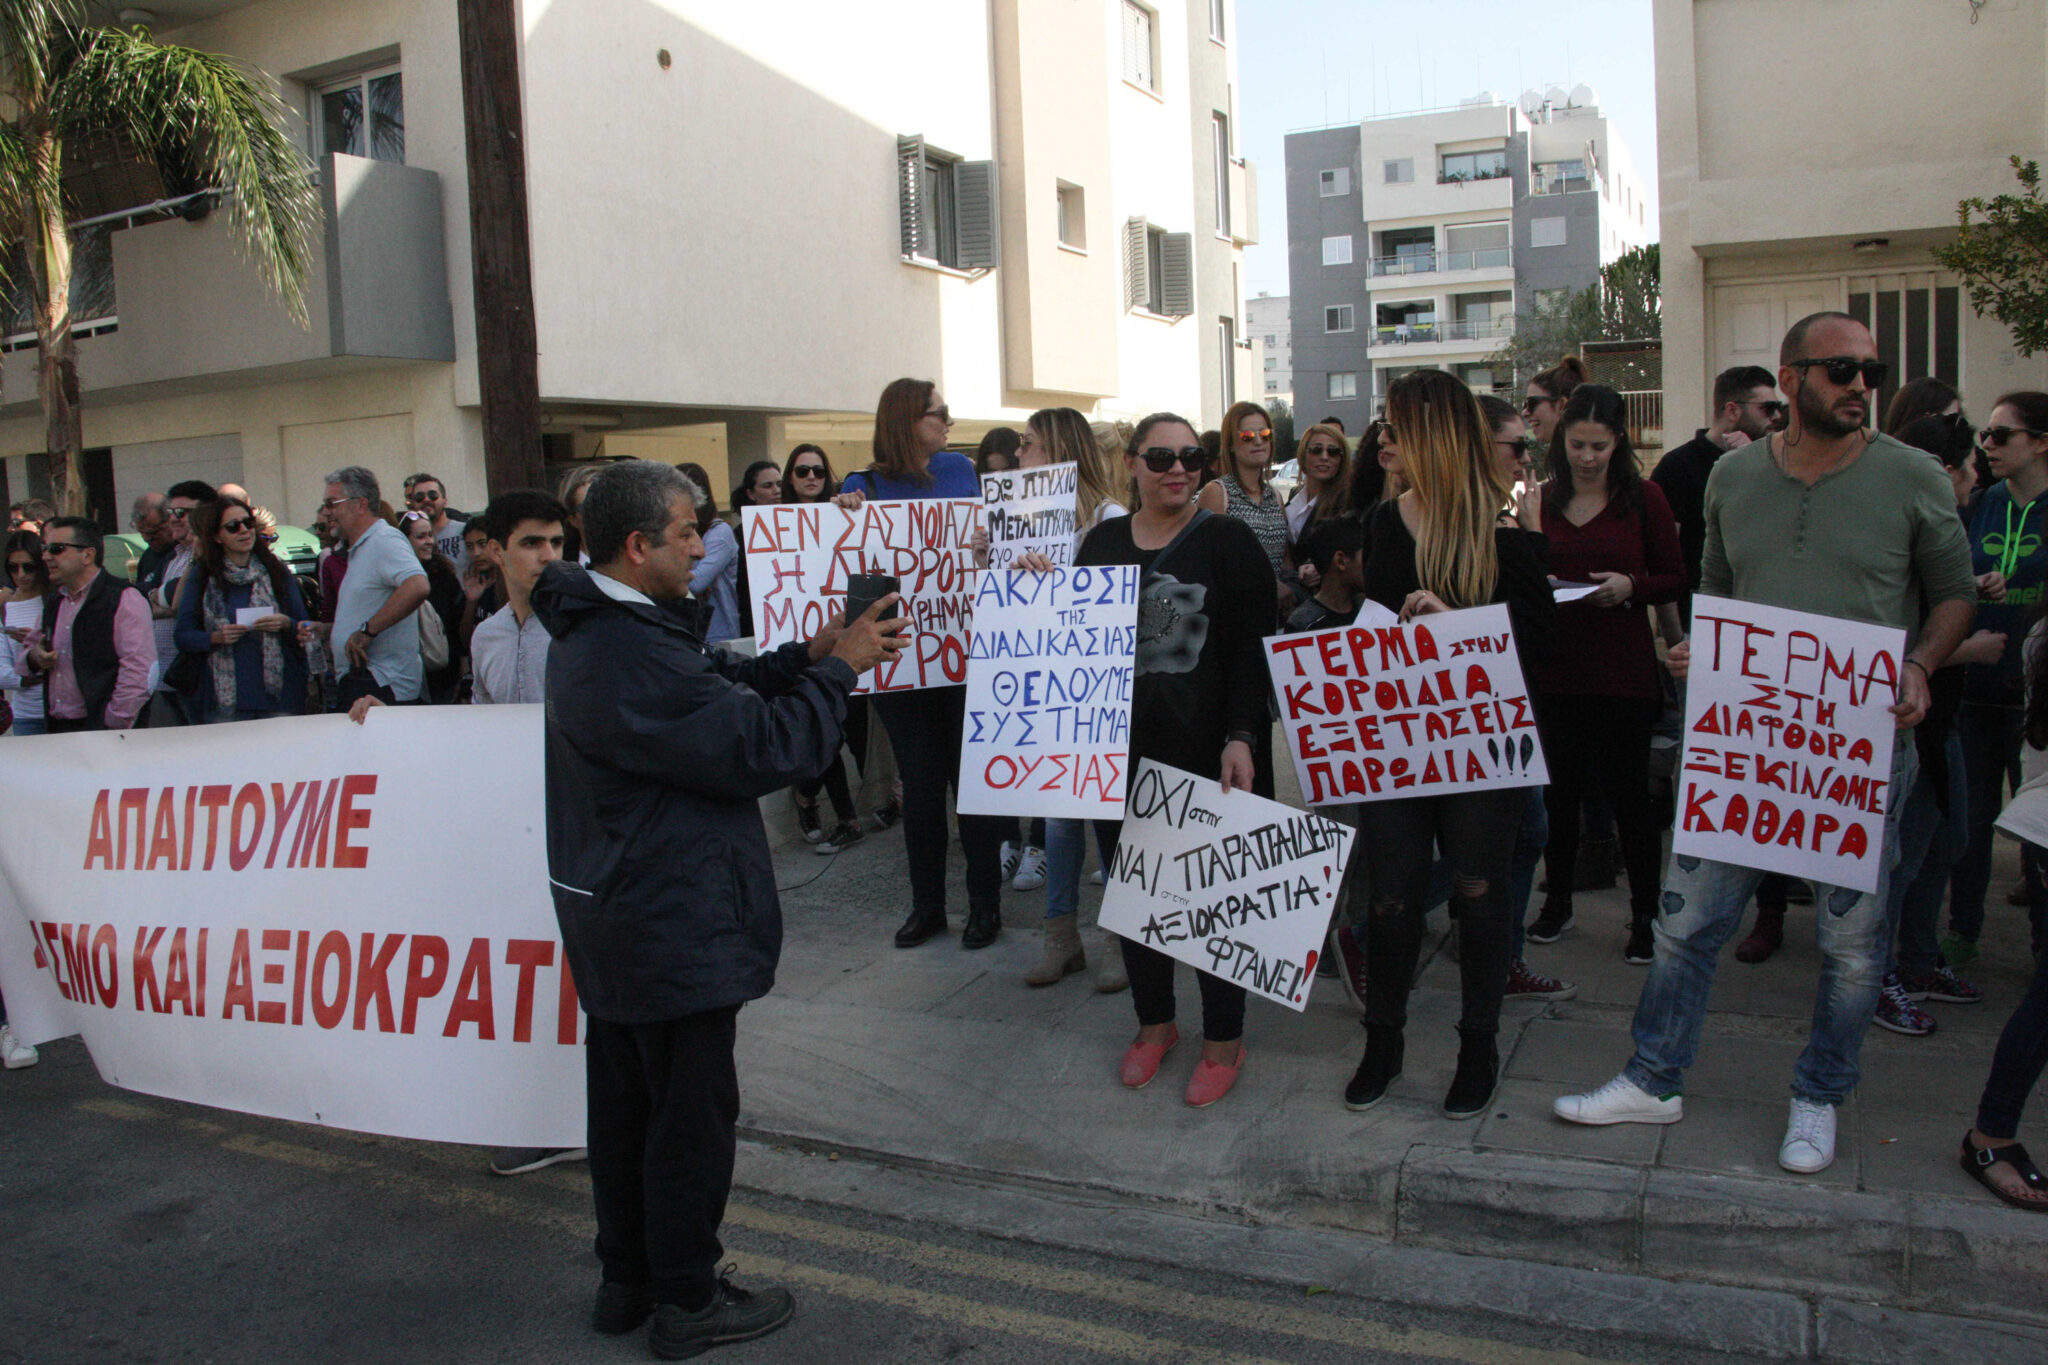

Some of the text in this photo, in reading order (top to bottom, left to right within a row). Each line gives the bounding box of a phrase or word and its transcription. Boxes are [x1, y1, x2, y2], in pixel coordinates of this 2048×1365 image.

[1021, 466, 1077, 500] ΠΤΥΧΙΟ
[747, 507, 820, 554] ΔΕΝ
[833, 503, 902, 551] ΣΑΣ
[764, 555, 806, 600] Η
[976, 566, 1137, 607] ΑΚΥΡΩΣΗ
[970, 625, 1136, 659] ΔΙΑΔΙΚΑΣΙΑΣ
[1057, 608, 1087, 626] ΤΗΣ
[1272, 624, 1510, 677] ΤΕΡΜΑ ΣΤΗΝ
[1694, 614, 1899, 709] ΤΕΡΜΑ
[993, 666, 1133, 707] ΘΕΛΟΥΜΕ
[1738, 683, 1836, 729] ΣΤΗ
[968, 706, 1129, 747] ΣΥΣΤΗΜΑ
[1692, 701, 1873, 767] ΔΙΑΦΘΟΡΑ
[984, 752, 1127, 802] ΟΥΣΙΑΣ
[1132, 768, 1195, 829] ΟΧΙ
[1683, 746, 1890, 815] ΞΕΚΙΝΑΜΕ
[83, 773, 378, 872] ΑΠΑΙΤΟΥΜΕ
[1682, 782, 1869, 860] ΚΑΘΑΡΑ
[1109, 842, 1163, 897] ΝΑΙ
[133, 926, 208, 1017] ΚΑΙ
[222, 928, 588, 1046] ΑΞΙΟΚΡΑΤΙ
[1205, 934, 1319, 1004] ΦΤΑΝΕΙ!
